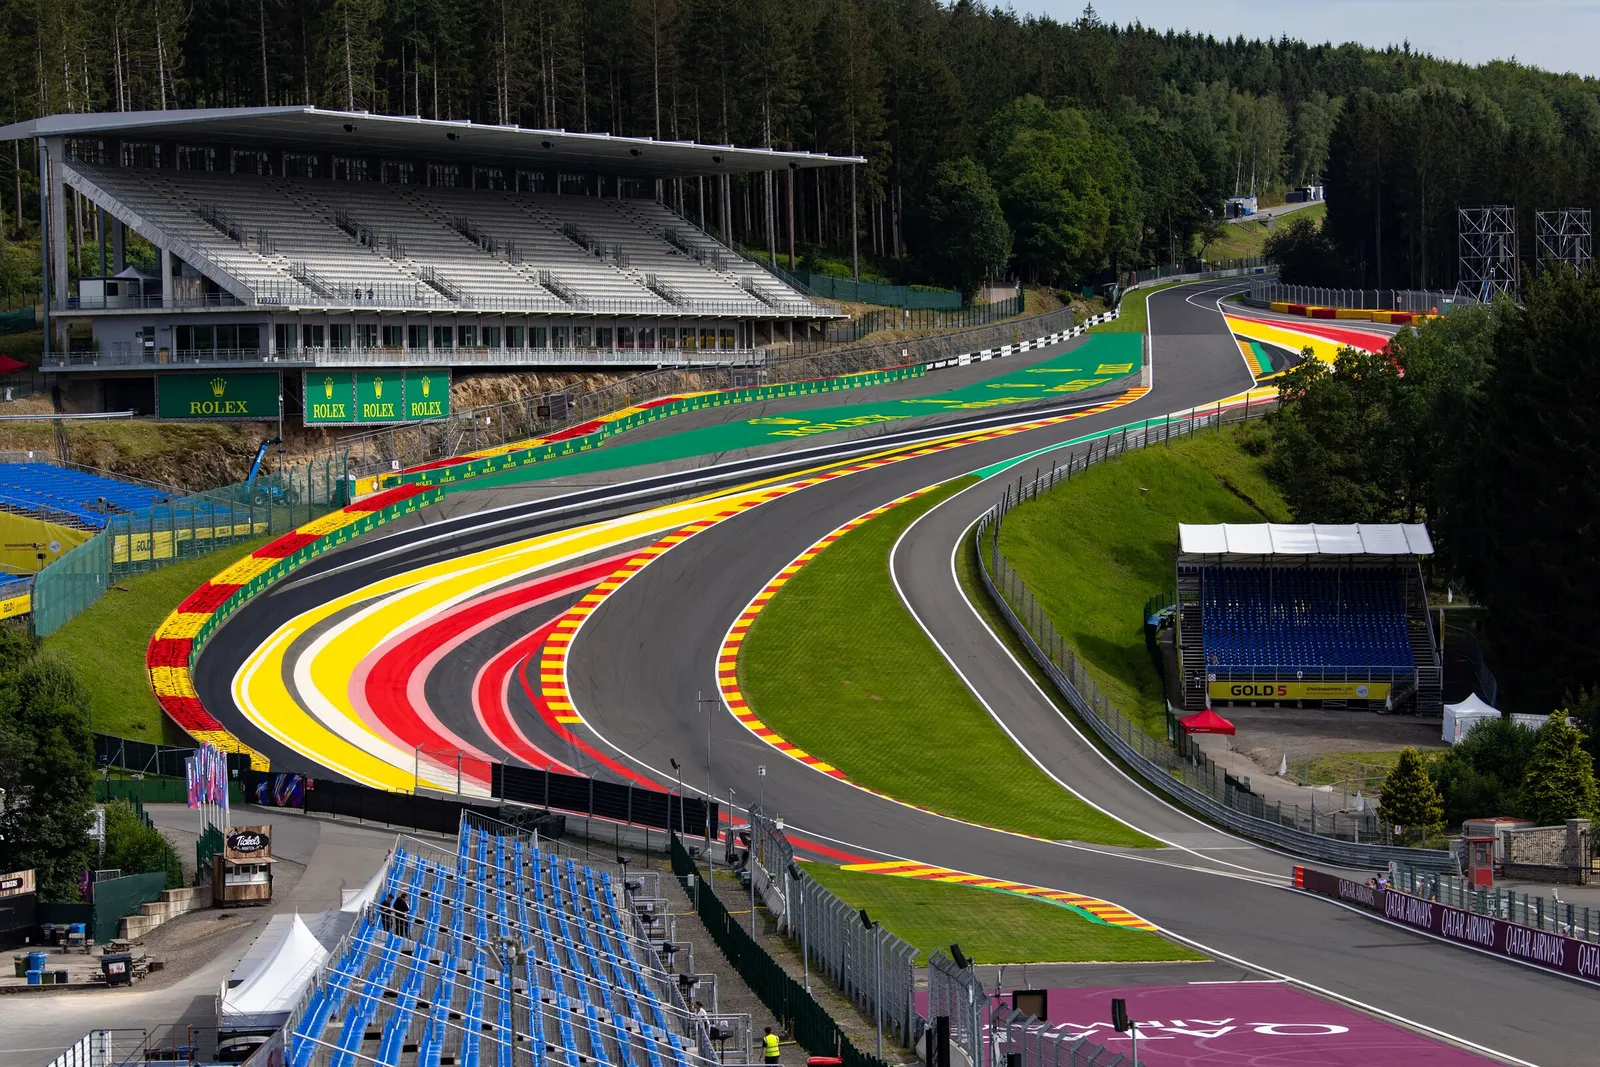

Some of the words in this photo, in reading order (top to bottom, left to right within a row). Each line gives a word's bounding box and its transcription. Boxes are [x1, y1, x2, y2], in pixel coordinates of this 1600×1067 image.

[190, 401, 248, 414] ROLEX
[313, 404, 346, 418] ROLEX
[363, 403, 395, 418] ROLEX
[411, 401, 442, 416] ROLEX
[767, 414, 913, 437] ROLEX
[1231, 685, 1274, 696] GOLD
[1278, 685, 1287, 696] 5
[236, 835, 261, 847] Tickets
[1339, 879, 1356, 899] QATAR
[1356, 885, 1375, 906] AIRWAYS
[1385, 891, 1405, 919] QATAR
[1405, 898, 1432, 928] AIRWAYS
[1441, 908, 1465, 938] QATAR
[1465, 915, 1495, 946] AIRWAYS
[1505, 925, 1531, 957] QATAR
[1531, 932, 1564, 966] AIRWAYS
